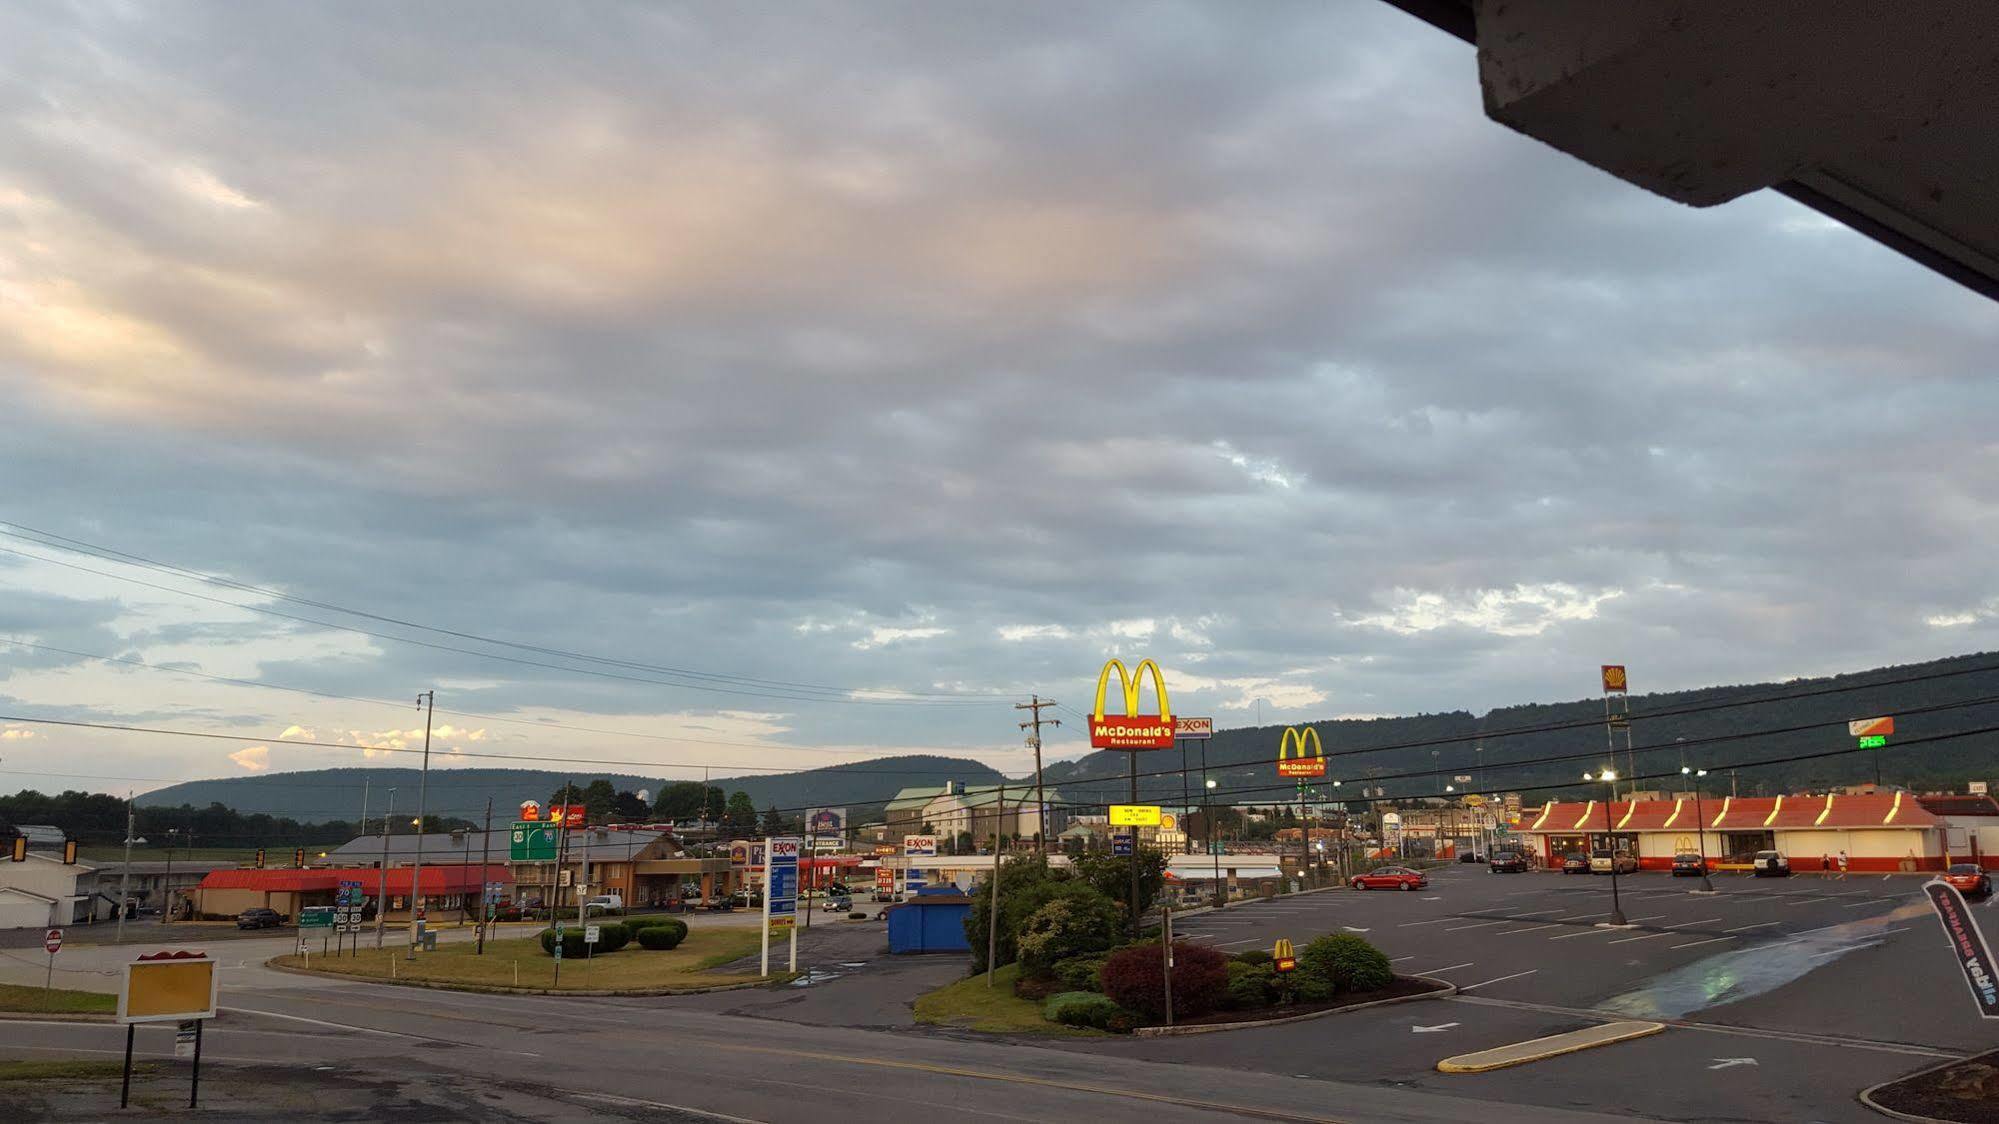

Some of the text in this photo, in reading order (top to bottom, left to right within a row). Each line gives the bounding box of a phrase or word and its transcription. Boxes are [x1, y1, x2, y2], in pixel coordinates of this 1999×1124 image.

[1176, 720, 1209, 731] EXXON
[1095, 726, 1171, 737] McDonald's
[773, 841, 796, 855] EXXON
[907, 838, 933, 848] EXXON
